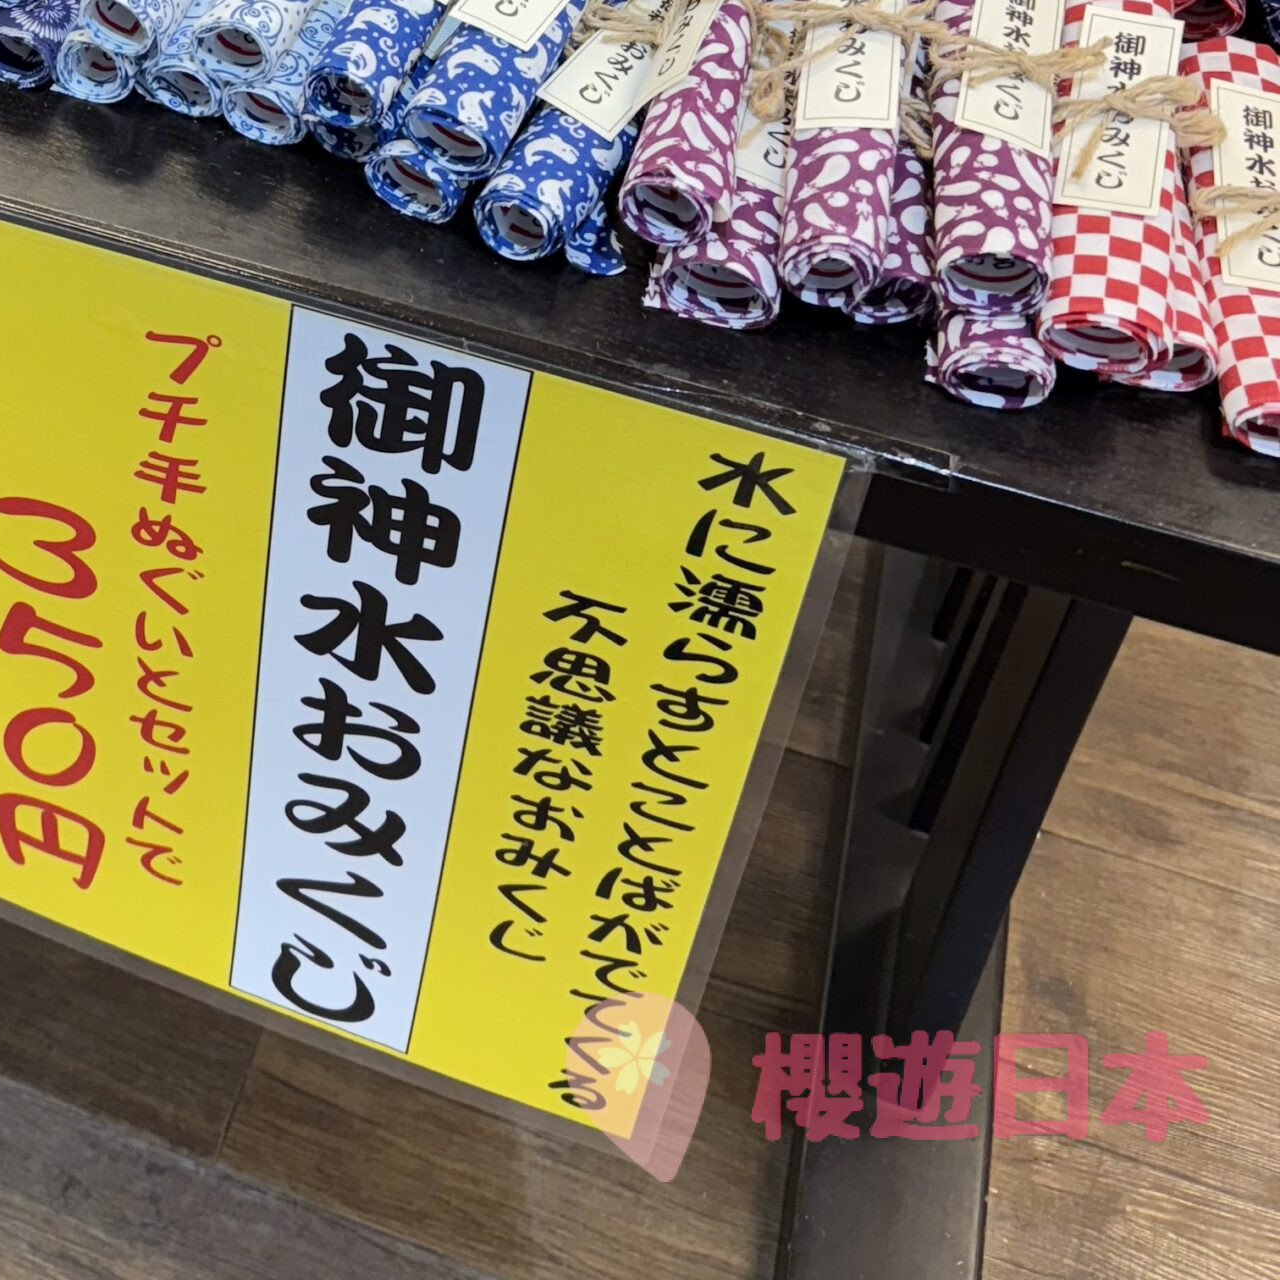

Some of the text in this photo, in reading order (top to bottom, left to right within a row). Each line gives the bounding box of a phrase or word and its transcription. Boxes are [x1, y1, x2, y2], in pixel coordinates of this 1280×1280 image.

[125, 330, 221, 885] プチ手ぬぐいとセットで
[269, 332, 484, 1023] 御神水おみくじ
[489, 592, 627, 961] 不思議なおみくじ
